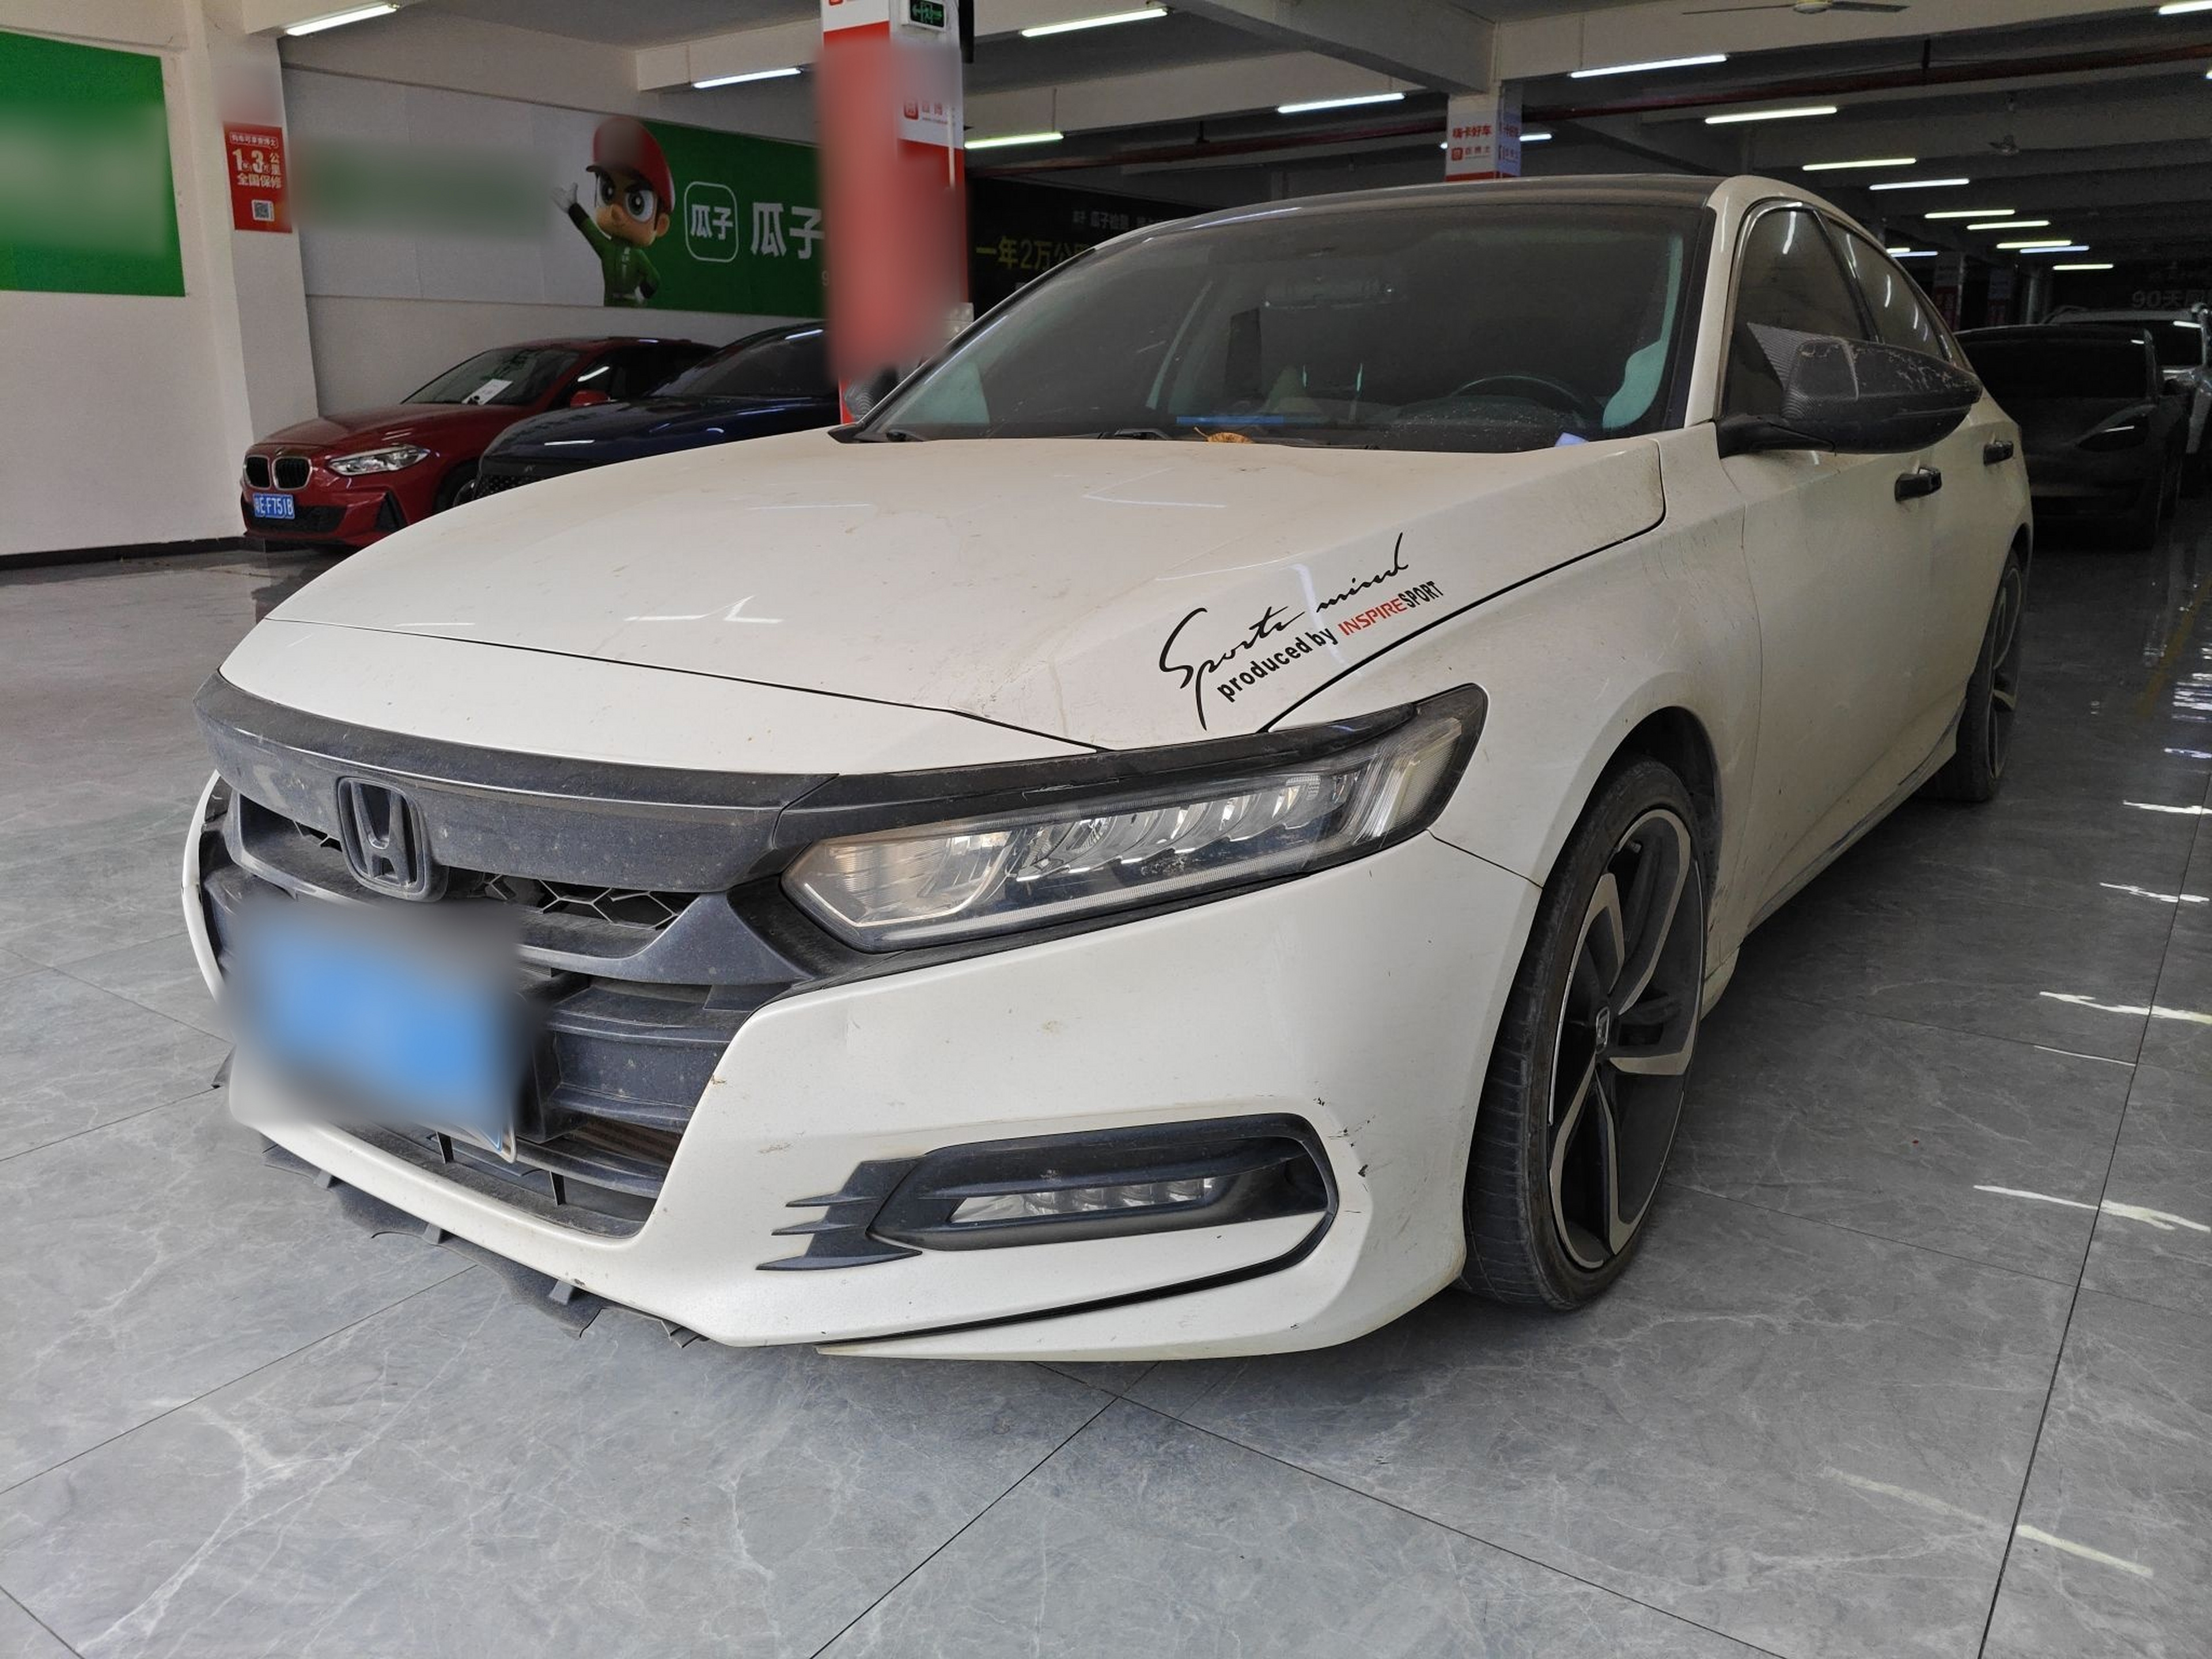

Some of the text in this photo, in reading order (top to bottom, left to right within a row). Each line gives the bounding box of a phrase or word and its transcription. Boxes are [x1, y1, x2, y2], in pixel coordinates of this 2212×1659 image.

[237, 173, 282, 189] 全国保修
[691, 204, 733, 240] 瓜子
[751, 202, 825, 259] 瓜子
[1217, 637, 1313, 703] produced
[1305, 628, 1339, 646] by
